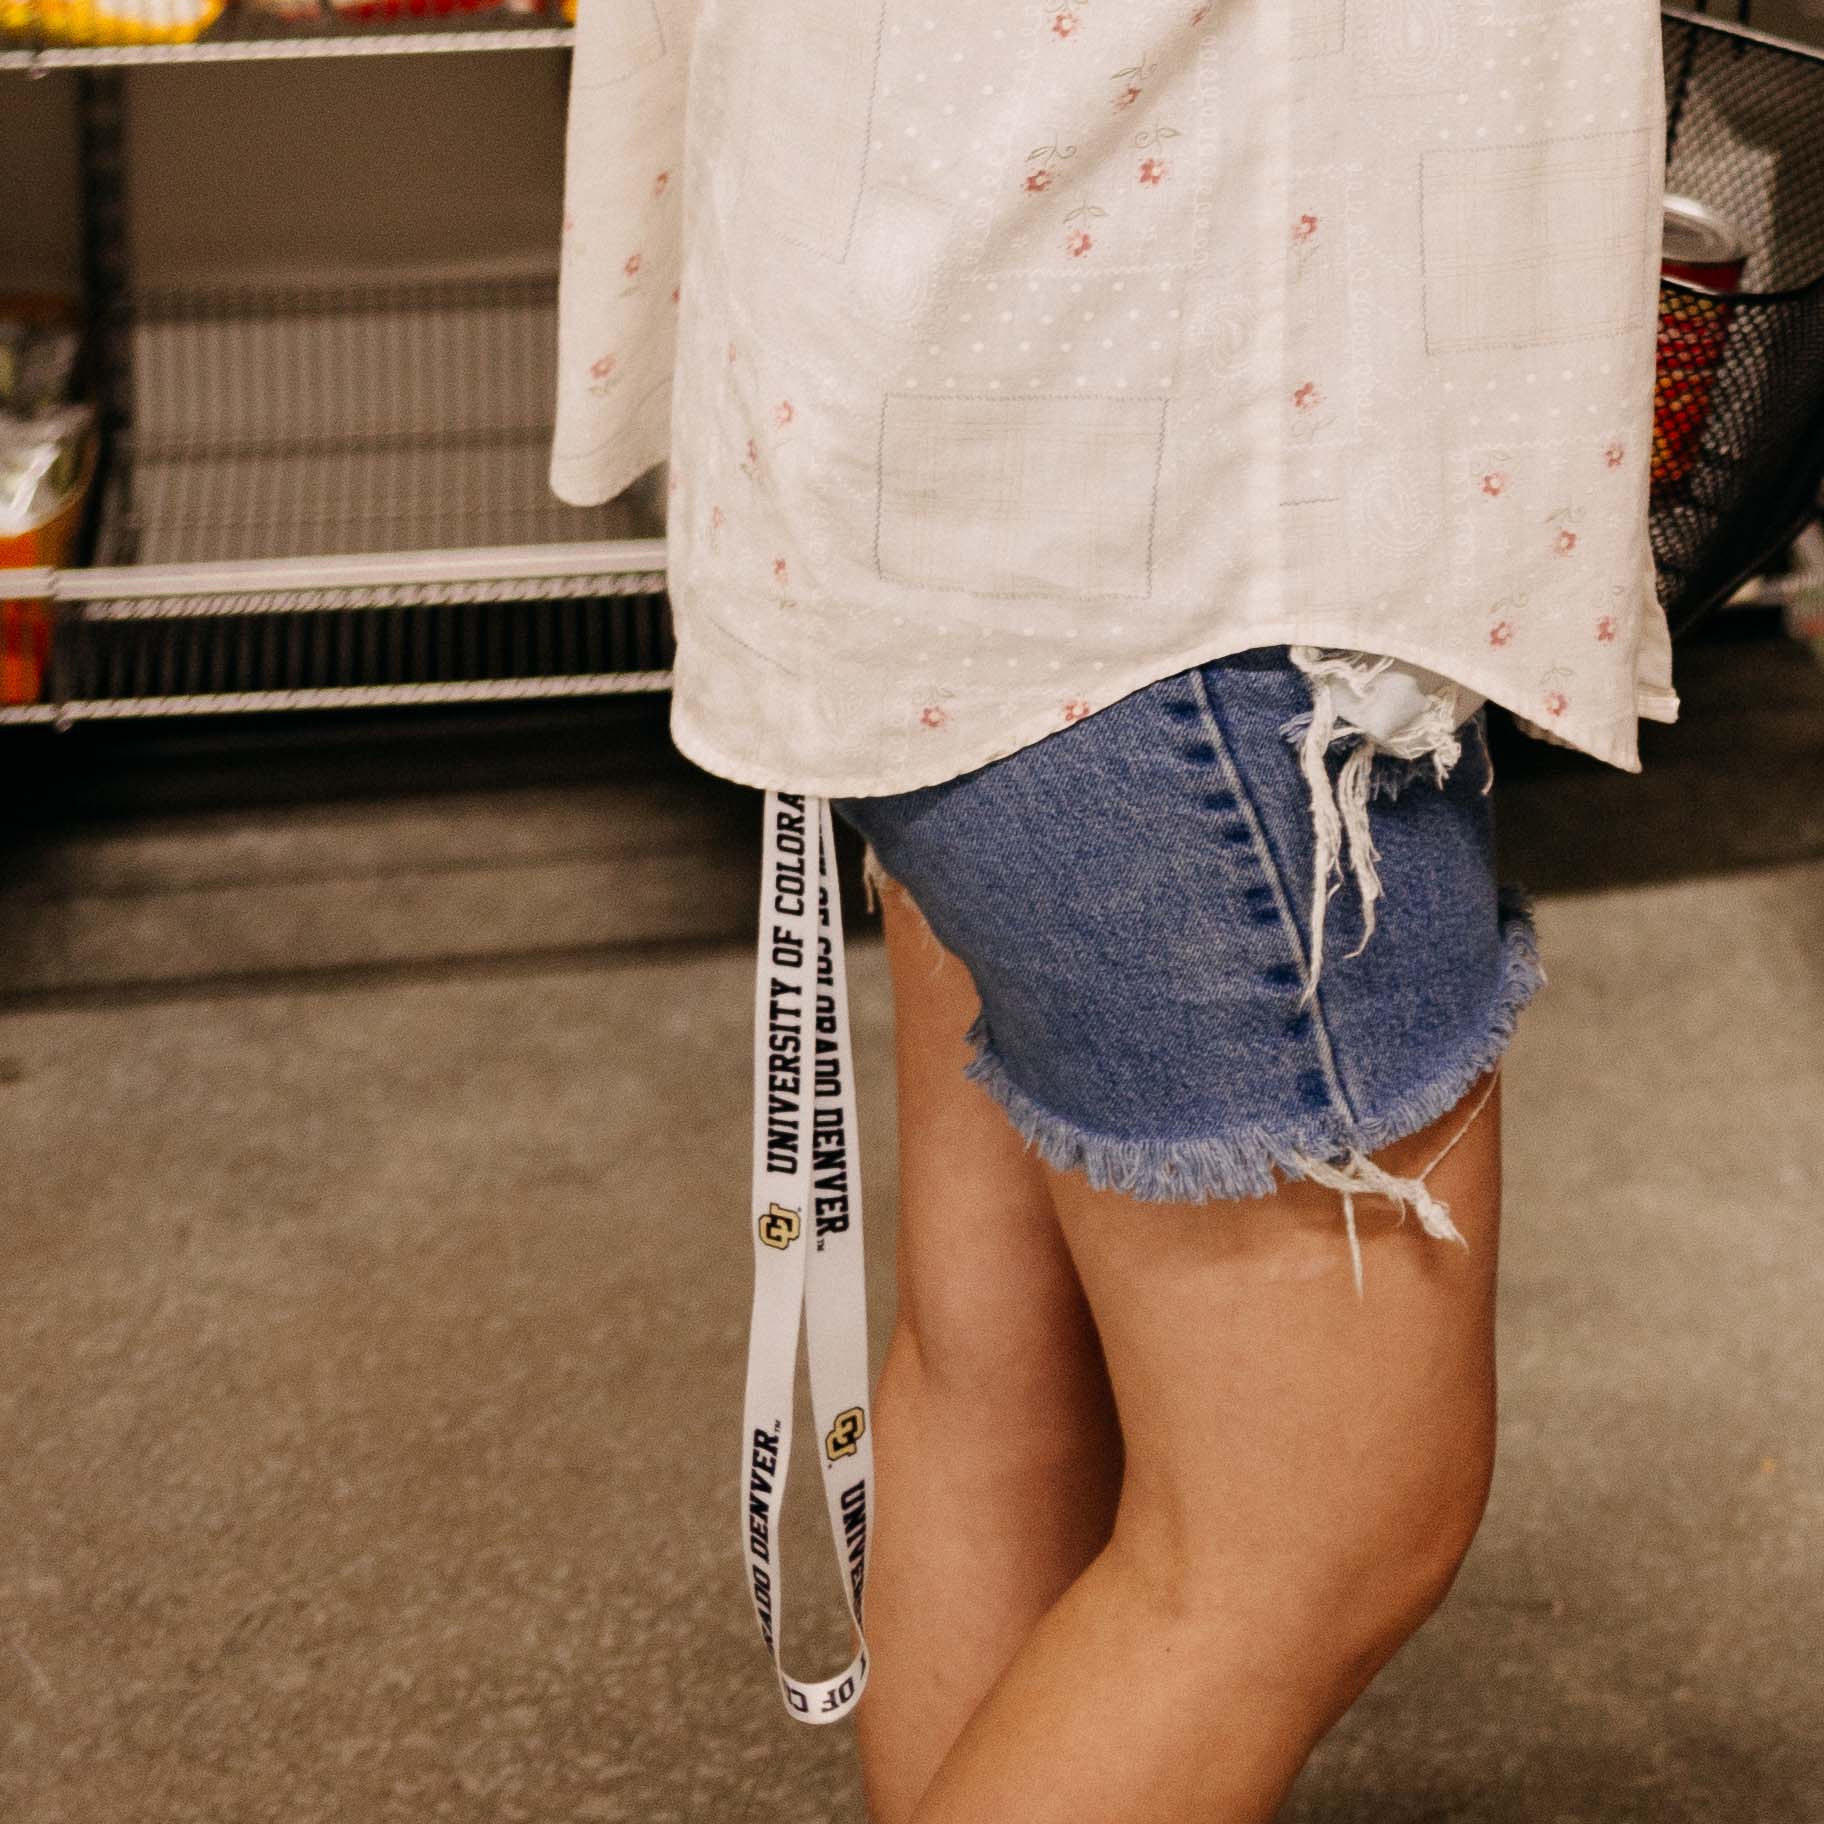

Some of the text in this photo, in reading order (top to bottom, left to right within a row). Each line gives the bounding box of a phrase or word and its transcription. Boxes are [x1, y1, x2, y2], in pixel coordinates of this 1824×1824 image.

[772, 925, 804, 969] OF
[767, 976, 803, 1175] UNIVERSITY
[813, 1107, 850, 1237] DENVER
[750, 1428, 779, 1565] DENVER
